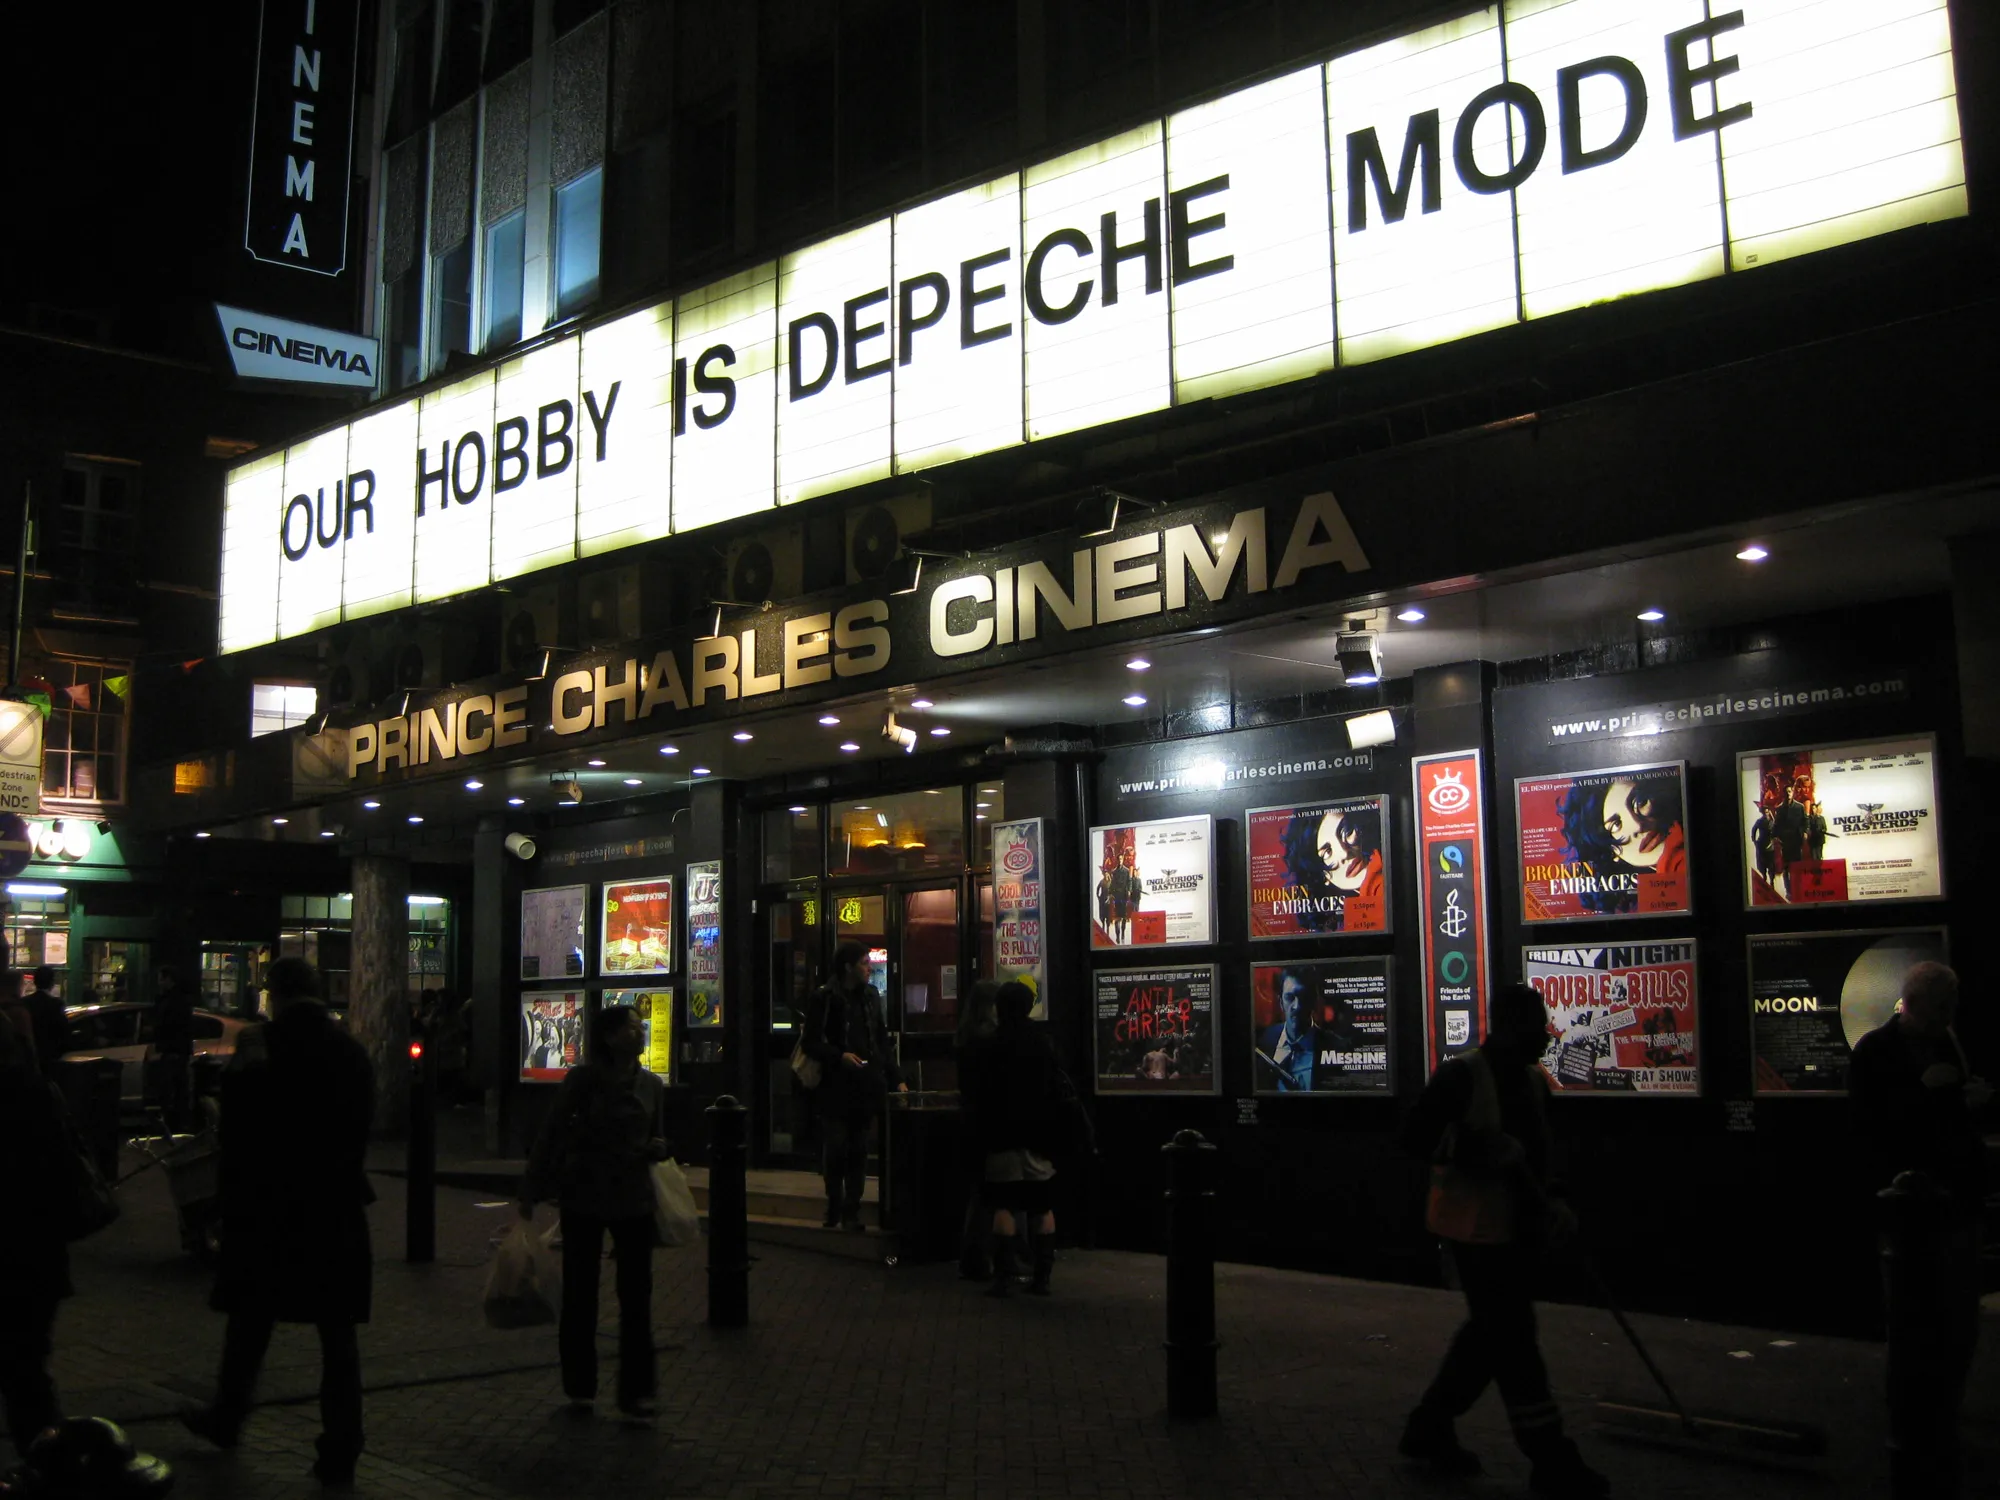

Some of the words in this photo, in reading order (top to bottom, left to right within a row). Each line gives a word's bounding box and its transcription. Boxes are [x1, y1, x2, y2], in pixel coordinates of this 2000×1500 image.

[281, 469, 376, 562] OUR
[417, 380, 622, 518] HOBBY
[674, 343, 737, 437] IS
[789, 173, 1235, 403] DEPECHE
[1346, 9, 1753, 234] MODE
[232, 327, 372, 377] CINEMA
[348, 685, 528, 779] PRINCE
[551, 600, 891, 736] CHARLES
[930, 491, 1371, 657] CINEMA
[1120, 752, 1369, 794] www.priarlescinema.com
[1, 782, 23, 792] Zone
[1583, 778, 1600, 787] FILM
[1842, 819, 1919, 833] BASTERDS
[1525, 861, 1593, 882] BROKEN
[998, 884, 1019, 899] COOL
[1024, 882, 1039, 898] OFF
[1151, 881, 1198, 892] BASTERDS
[1550, 873, 1638, 895] EMBRACES
[1253, 885, 1309, 903] BROKEN
[1273, 896, 1345, 915] EMBRACES
[1001, 923, 1016, 938] THE
[1020, 921, 1039, 936] PCC
[1001, 941, 1009, 956] IS
[1012, 940, 1039, 955] FULLY
[1528, 949, 1604, 968] FRIDAY
[1611, 944, 1692, 969] NIGHT
[1126, 986, 1175, 1012] ANTI
[1530, 973, 1613, 1011] DOUBLE
[1626, 970, 1689, 1012] BILLS
[1754, 997, 1818, 1013] MOON
[1596, 1022, 1612, 1033] CULT
[1615, 1036, 1630, 1044] THE
[1320, 1050, 1387, 1065] MESRINE
[1595, 1070, 1627, 1080] Today
[1659, 1068, 1697, 1083] SHOWS
